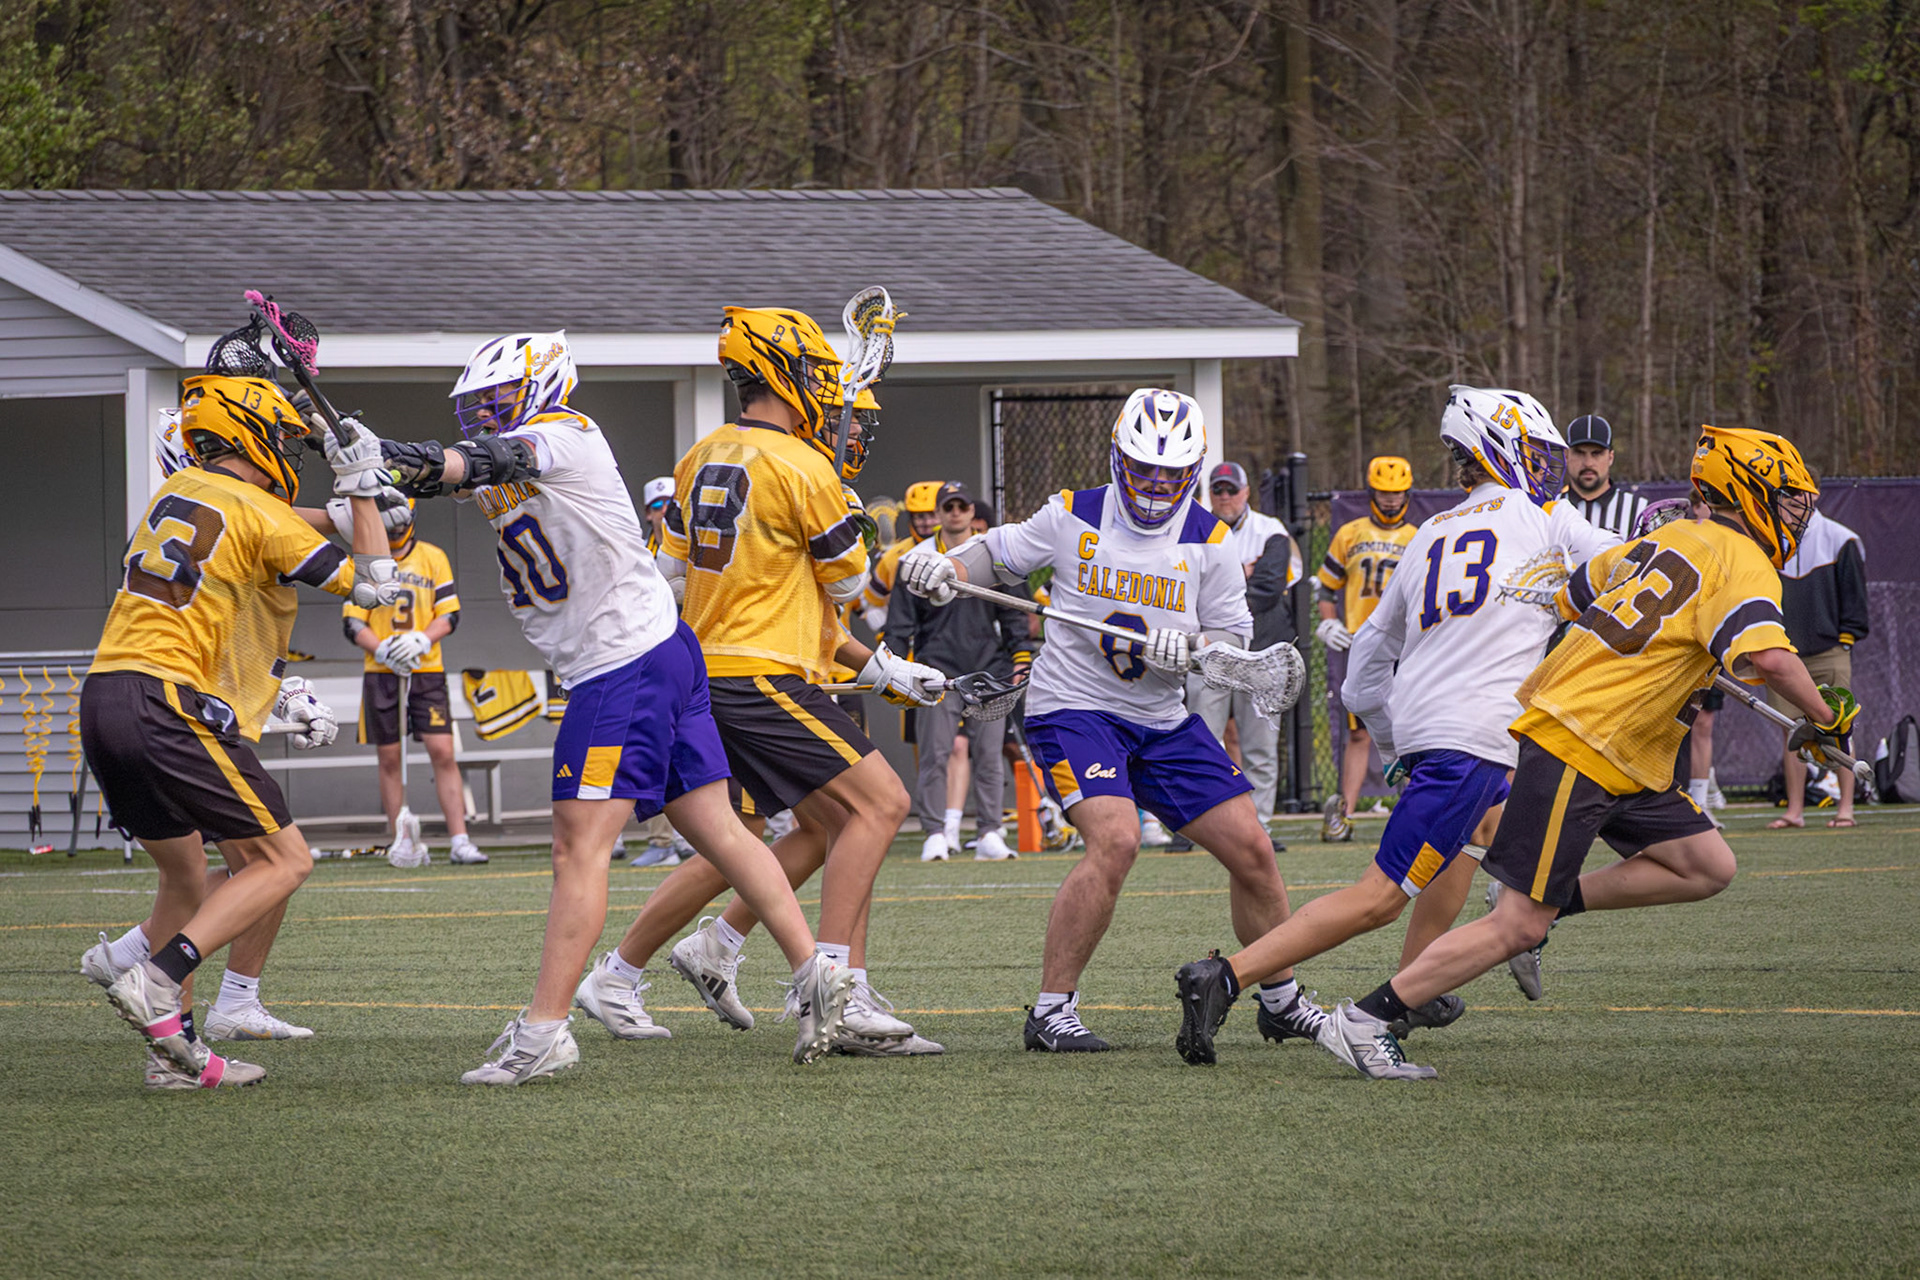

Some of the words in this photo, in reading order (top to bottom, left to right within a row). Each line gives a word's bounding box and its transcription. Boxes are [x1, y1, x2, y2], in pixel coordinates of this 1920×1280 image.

[771, 324, 786, 343] 8
[531, 342, 564, 376] Scots
[241, 387, 262, 410] 13
[1490, 402, 1516, 430] 13
[163, 421, 178, 442] 2
[1747, 448, 1775, 477] 23
[688, 463, 752, 575] 8
[1078, 531, 1100, 560] C
[1077, 563, 1187, 614] CALEDONIA
[1419, 528, 1499, 632] 13
[391, 589, 415, 632] 3
[1084, 762, 1117, 780] Cal
